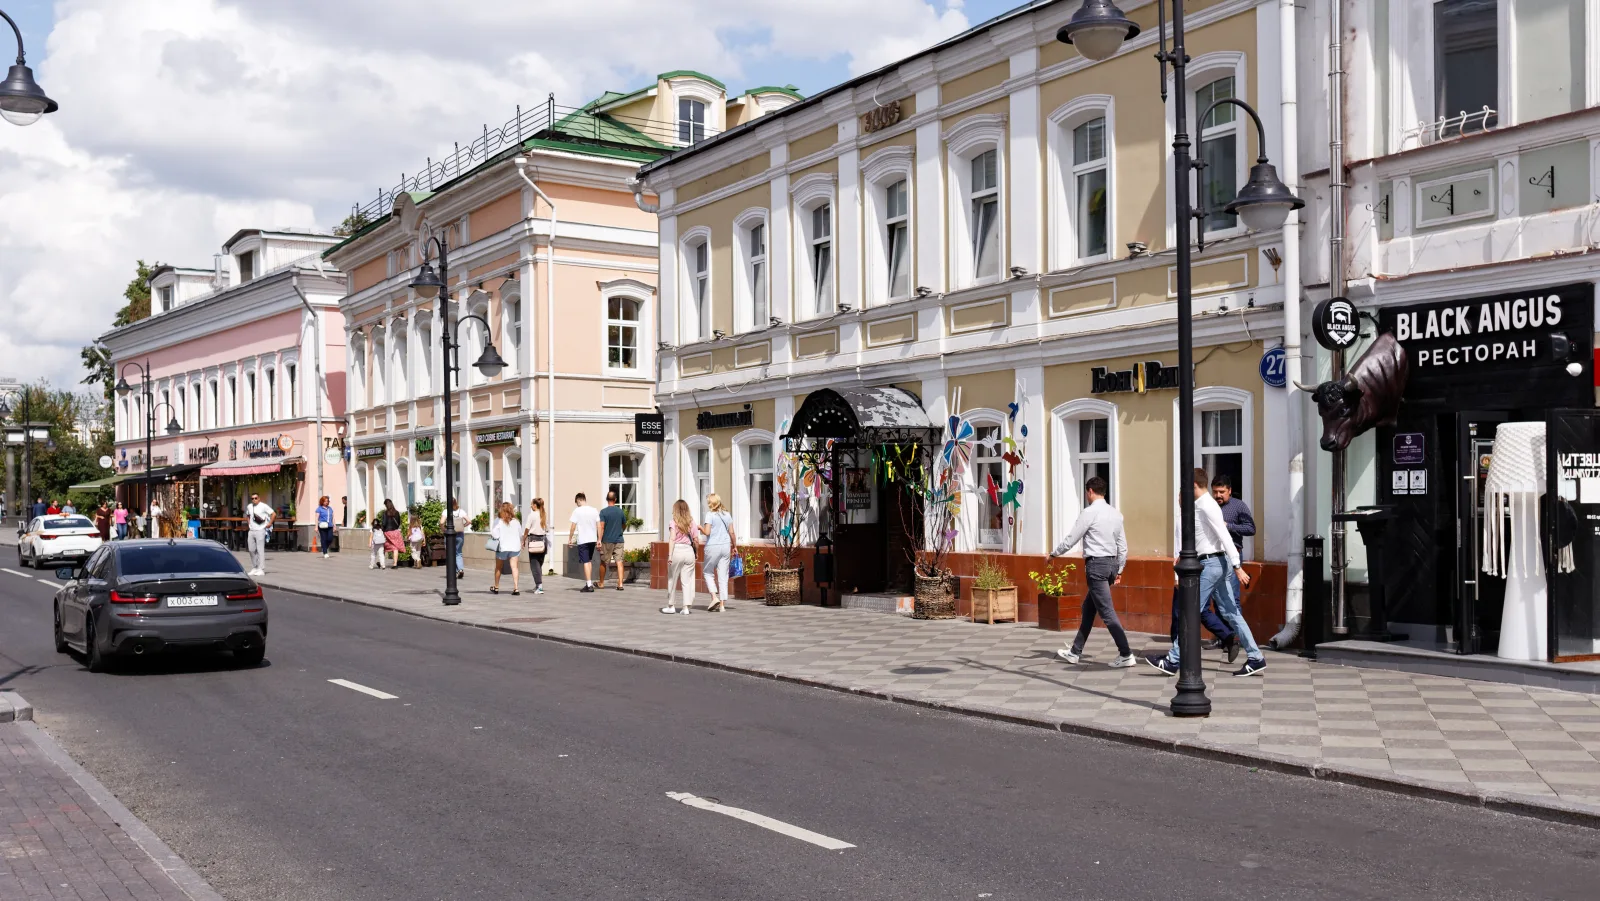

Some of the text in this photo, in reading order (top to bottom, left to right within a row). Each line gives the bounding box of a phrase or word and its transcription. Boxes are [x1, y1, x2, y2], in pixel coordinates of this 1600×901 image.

[1342, 324, 1356, 332] ANGUS
[1396, 294, 1562, 341] BLACK ANGUS
[1418, 339, 1536, 367] РЕСТОРАН
[1266, 354, 1286, 375] 27
[641, 421, 661, 430] ESSE
